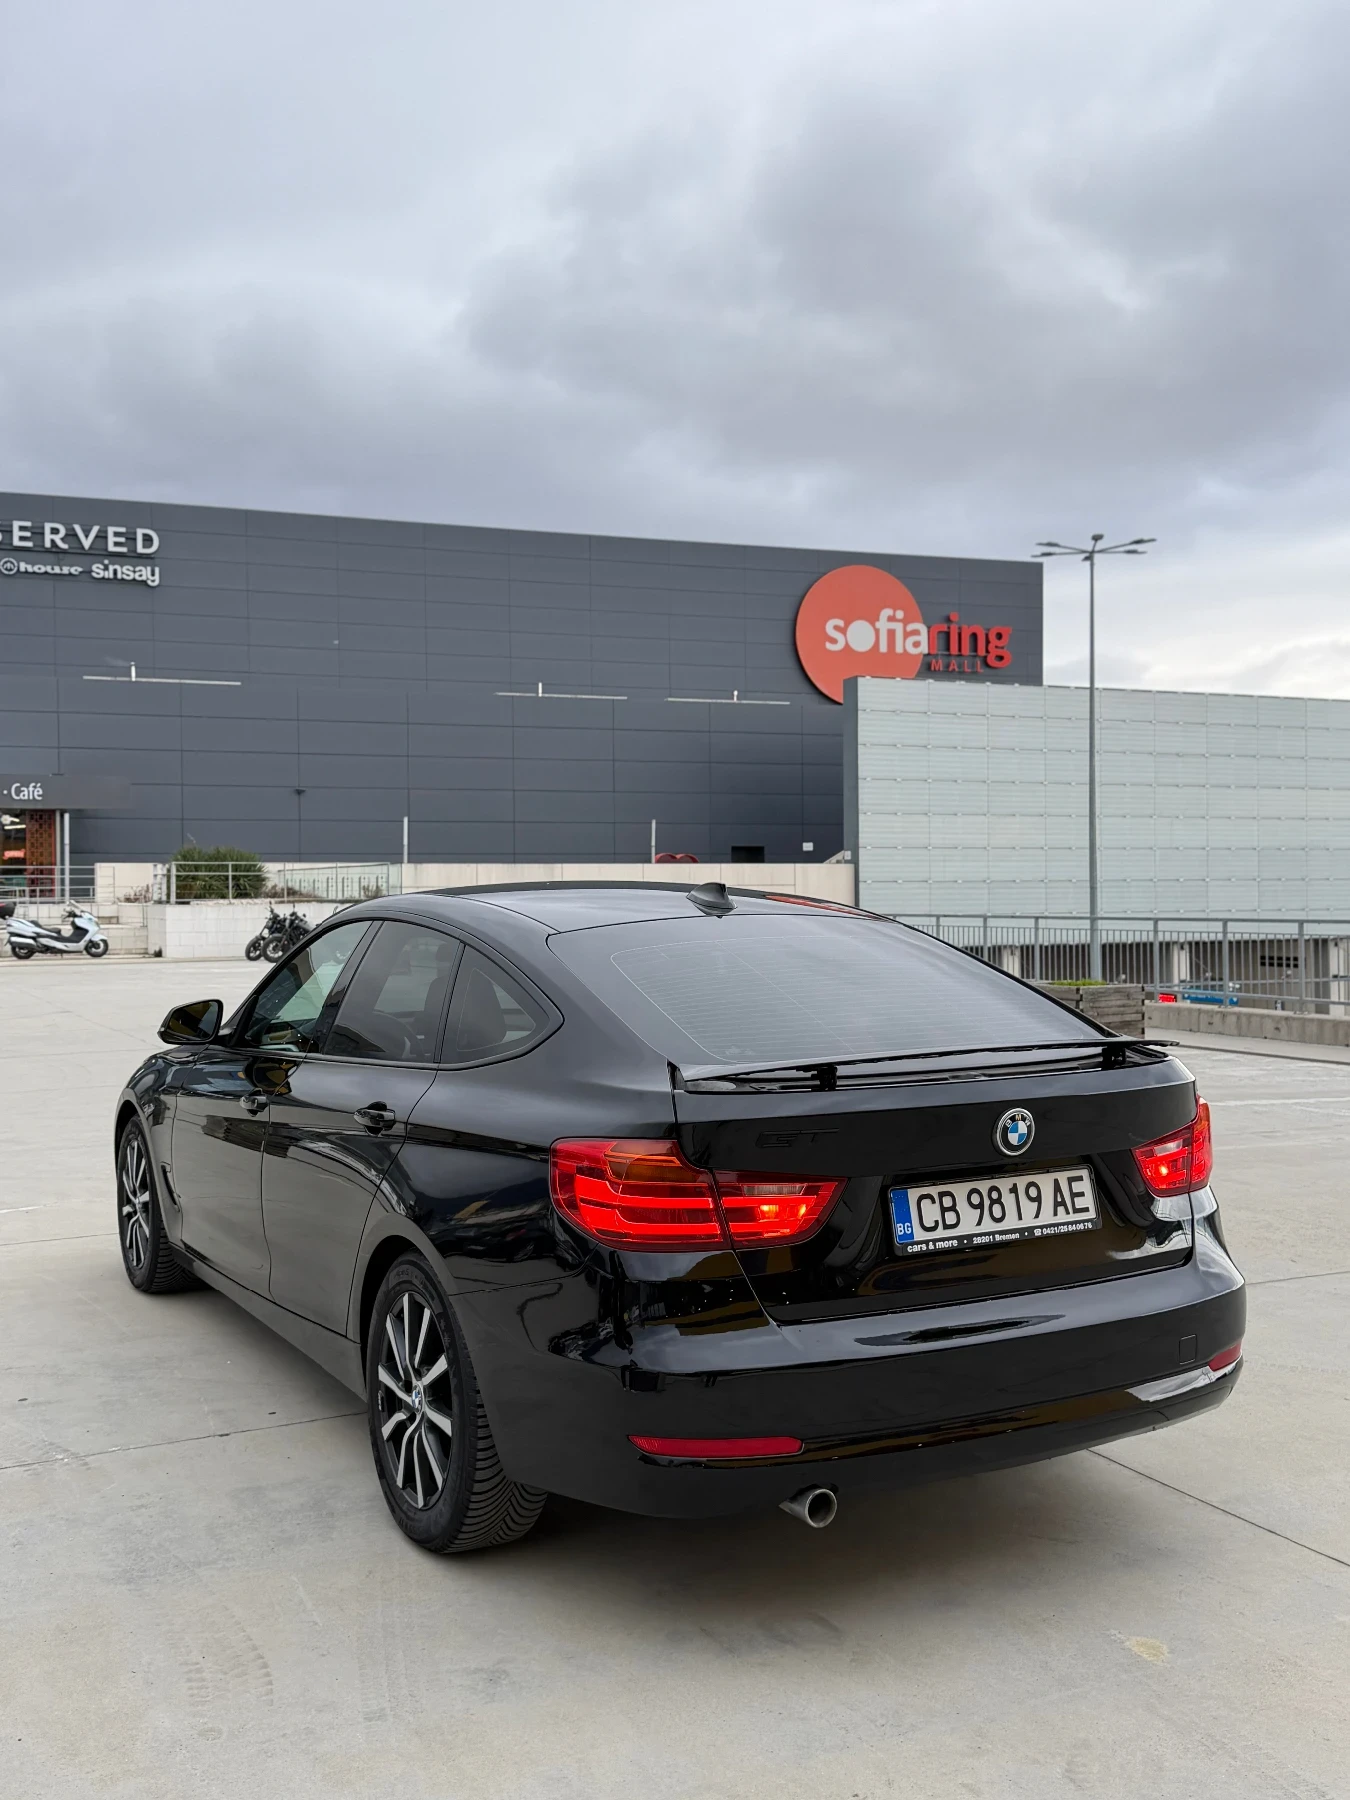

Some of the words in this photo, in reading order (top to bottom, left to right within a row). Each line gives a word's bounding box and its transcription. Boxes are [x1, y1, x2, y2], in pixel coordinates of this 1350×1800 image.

[0, 519, 160, 555] ERVED
[19, 561, 84, 576] house
[91, 559, 160, 587] sinsay
[930, 659, 984, 673] MALL
[11, 783, 43, 800] Café
[916, 1191, 961, 1233] CB
[967, 1181, 1043, 1227] 9819
[1053, 1175, 1090, 1217] AE
[896, 1222, 912, 1235] BG
[907, 1242, 927, 1252] cars
[928, 1241, 935, 1250] &
[935, 1239, 958, 1249] more
